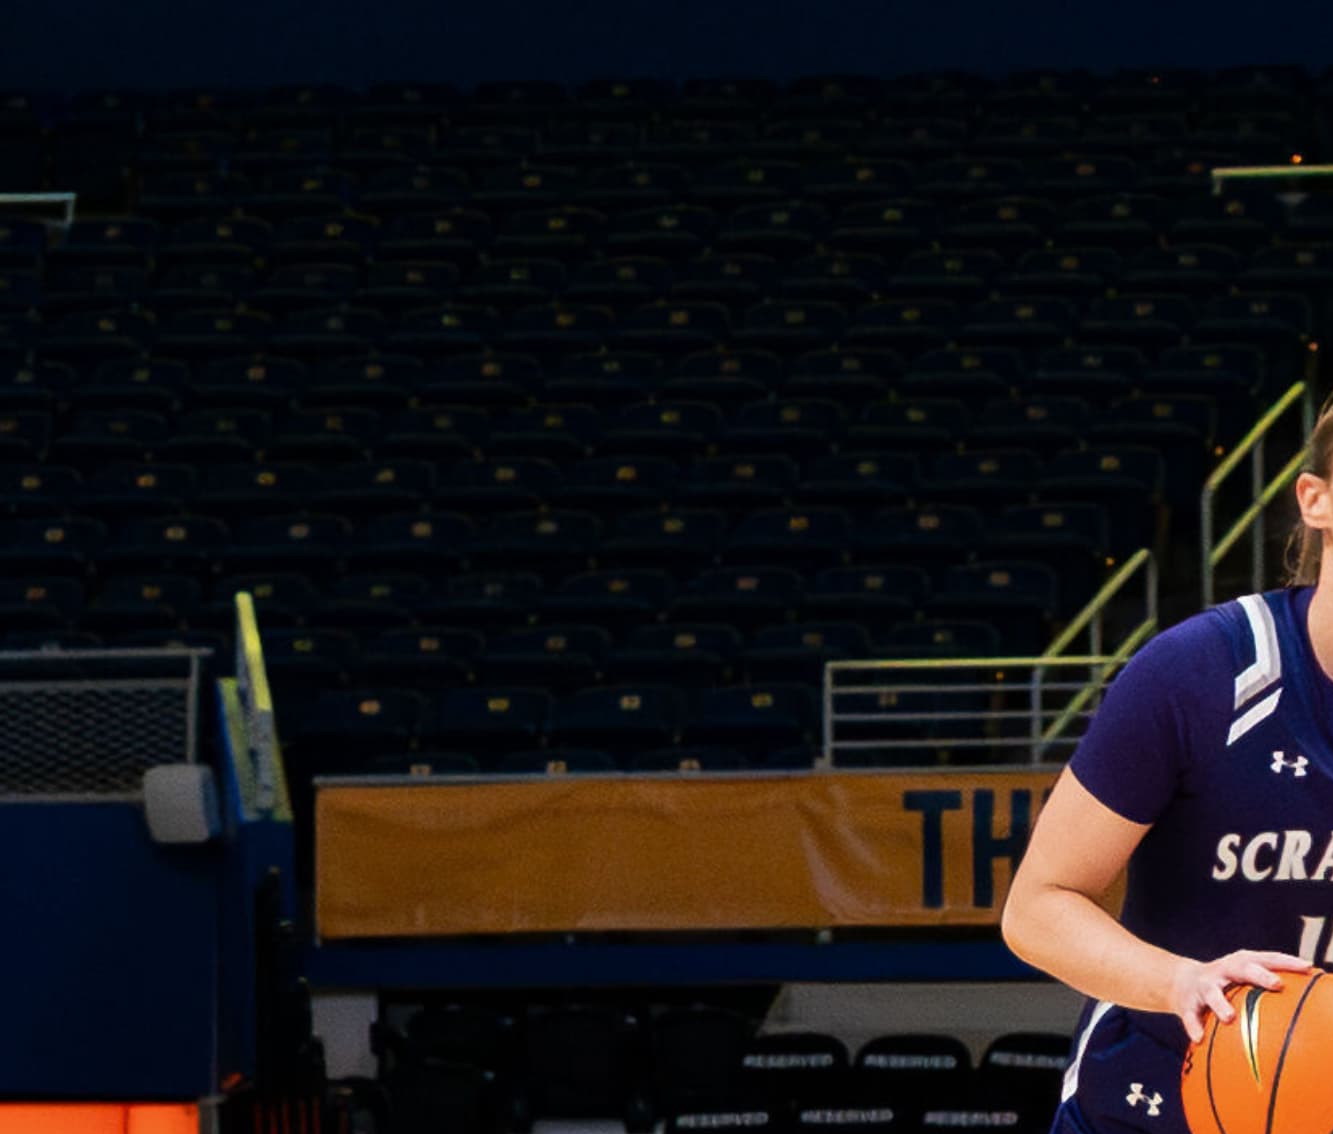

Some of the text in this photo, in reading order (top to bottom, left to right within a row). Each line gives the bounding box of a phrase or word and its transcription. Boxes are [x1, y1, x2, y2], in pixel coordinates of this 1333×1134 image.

[903, 788, 1054, 909] TH
[743, 1053, 835, 1069] RESERVED
[863, 1053, 958, 1070] RESERVED
[800, 1108, 895, 1125] RESERVED
[923, 1110, 1019, 1128] RESERVED
